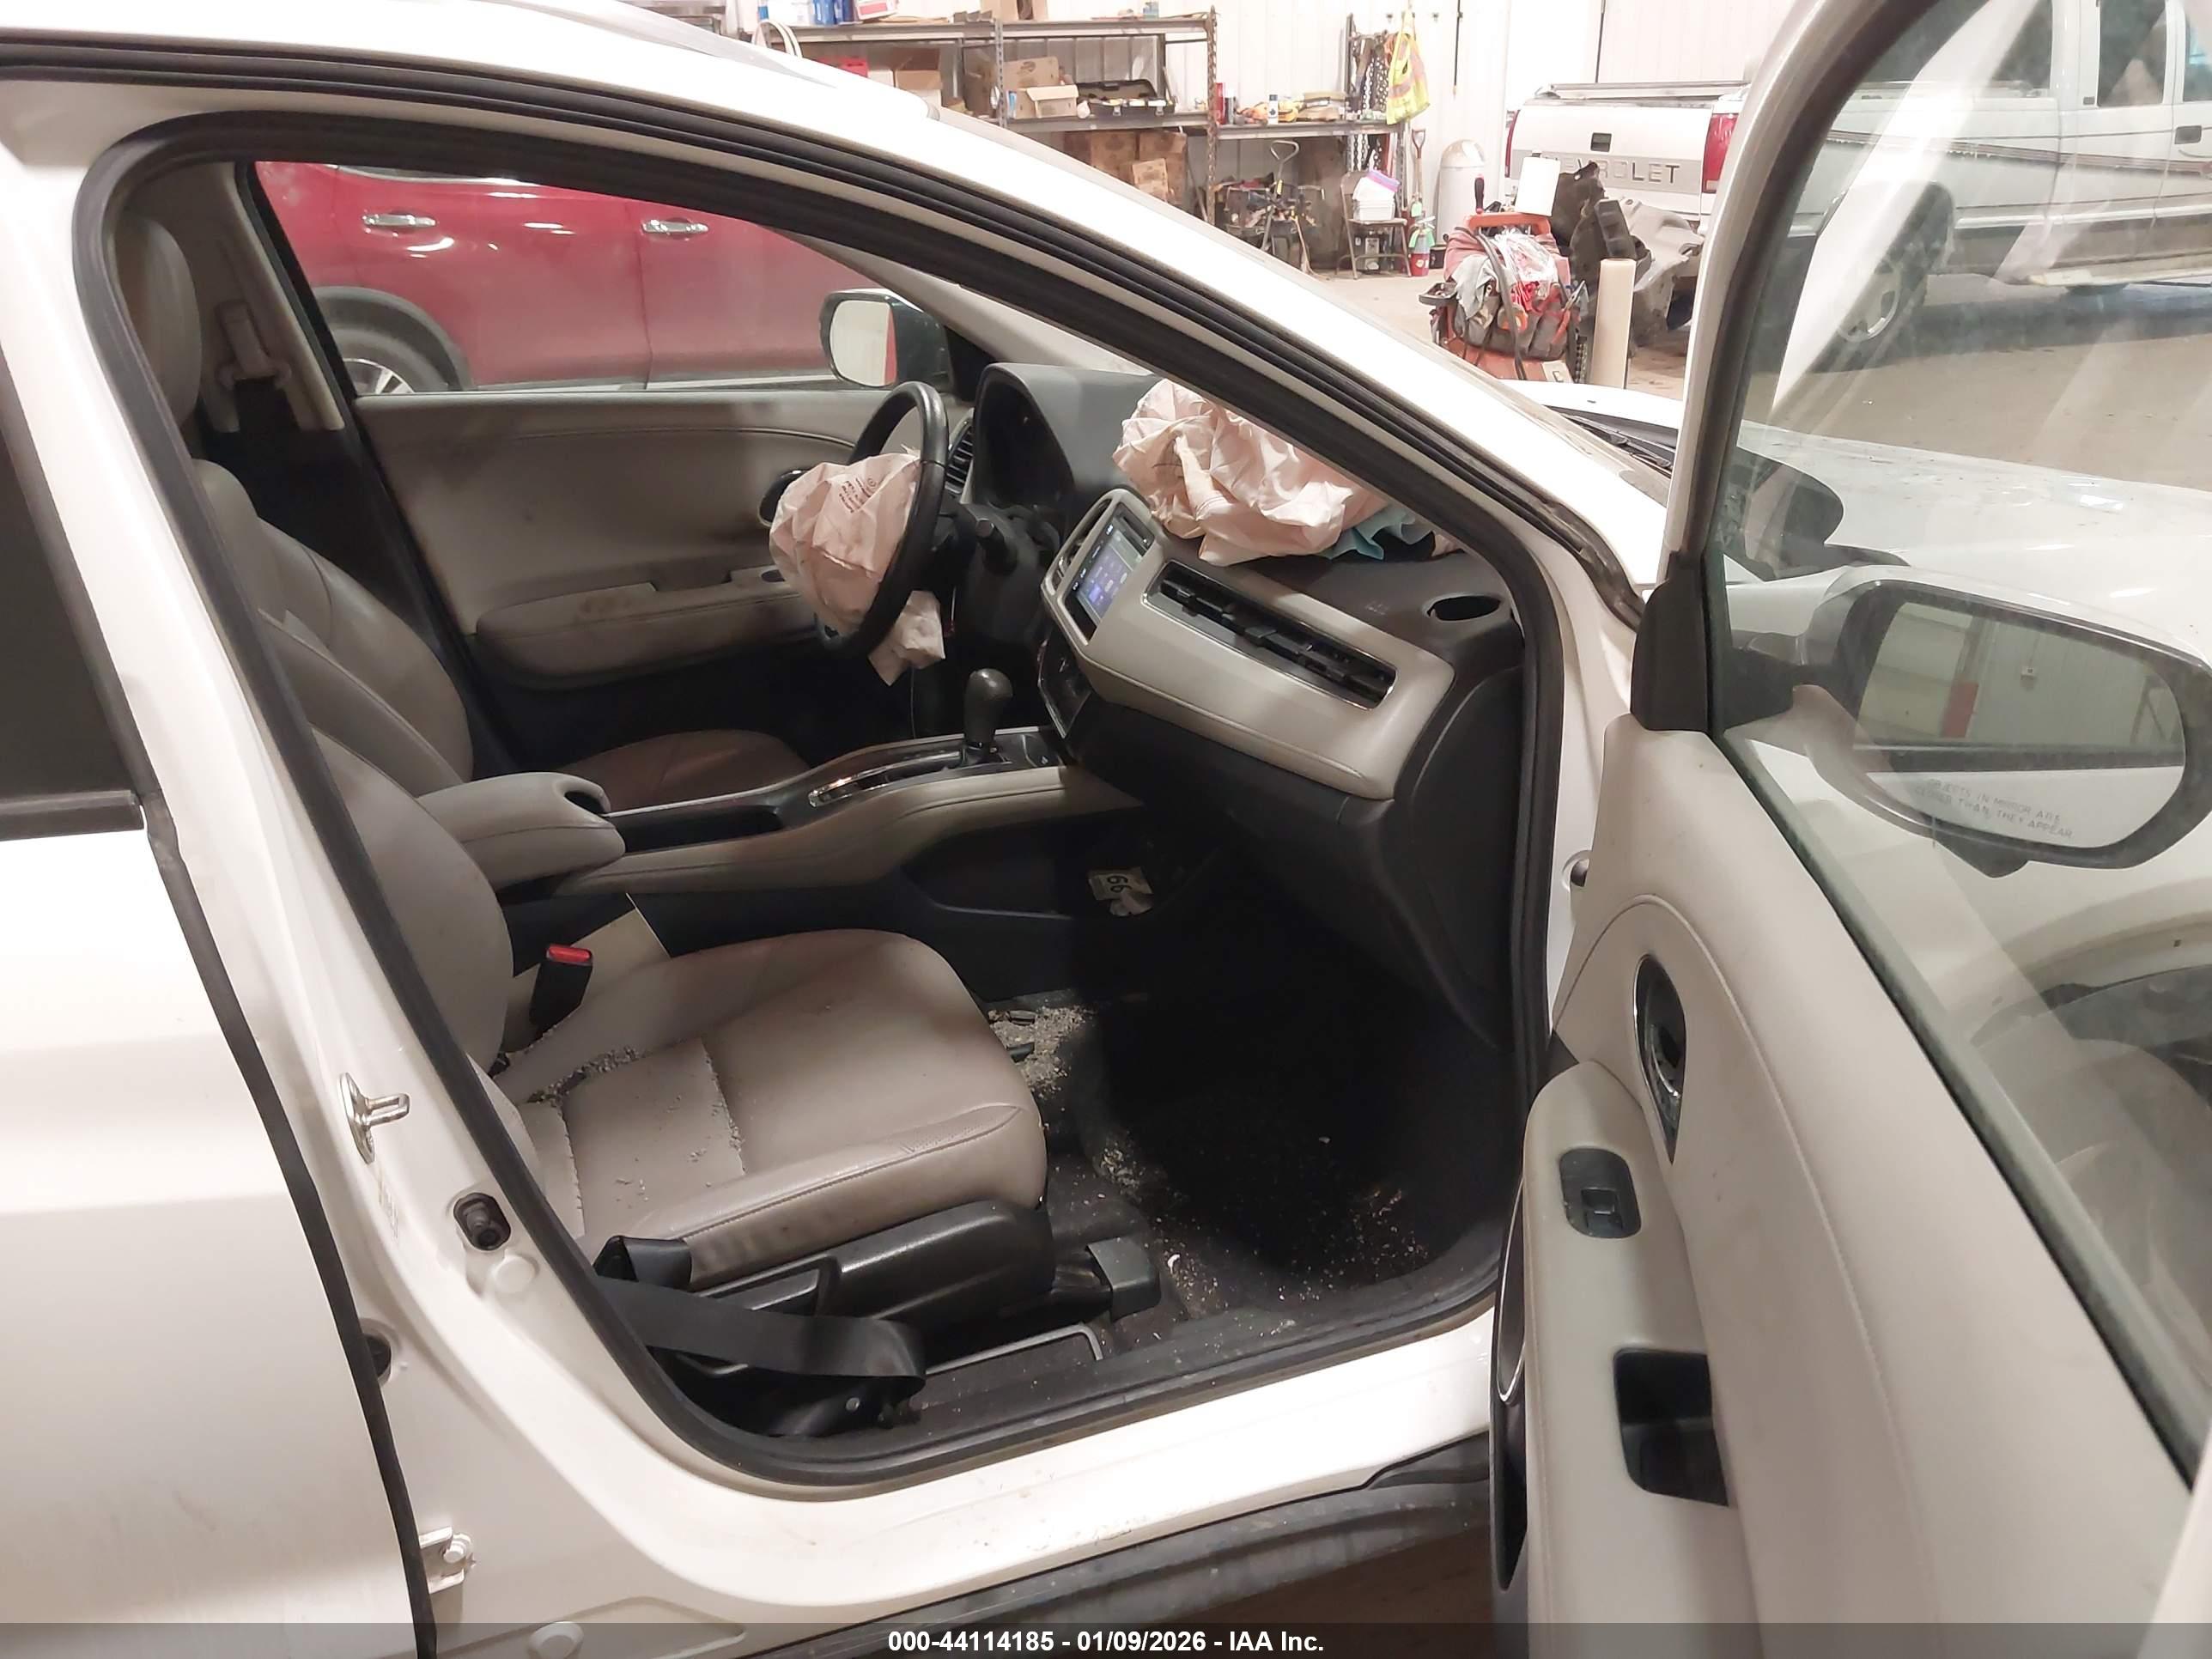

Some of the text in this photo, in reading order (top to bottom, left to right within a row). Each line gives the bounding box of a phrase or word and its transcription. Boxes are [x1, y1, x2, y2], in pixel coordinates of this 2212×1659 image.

[1977, 792, 1990, 805] IN
[2035, 810, 2061, 823] ARE
[2027, 819, 2073, 839] APPEAR
